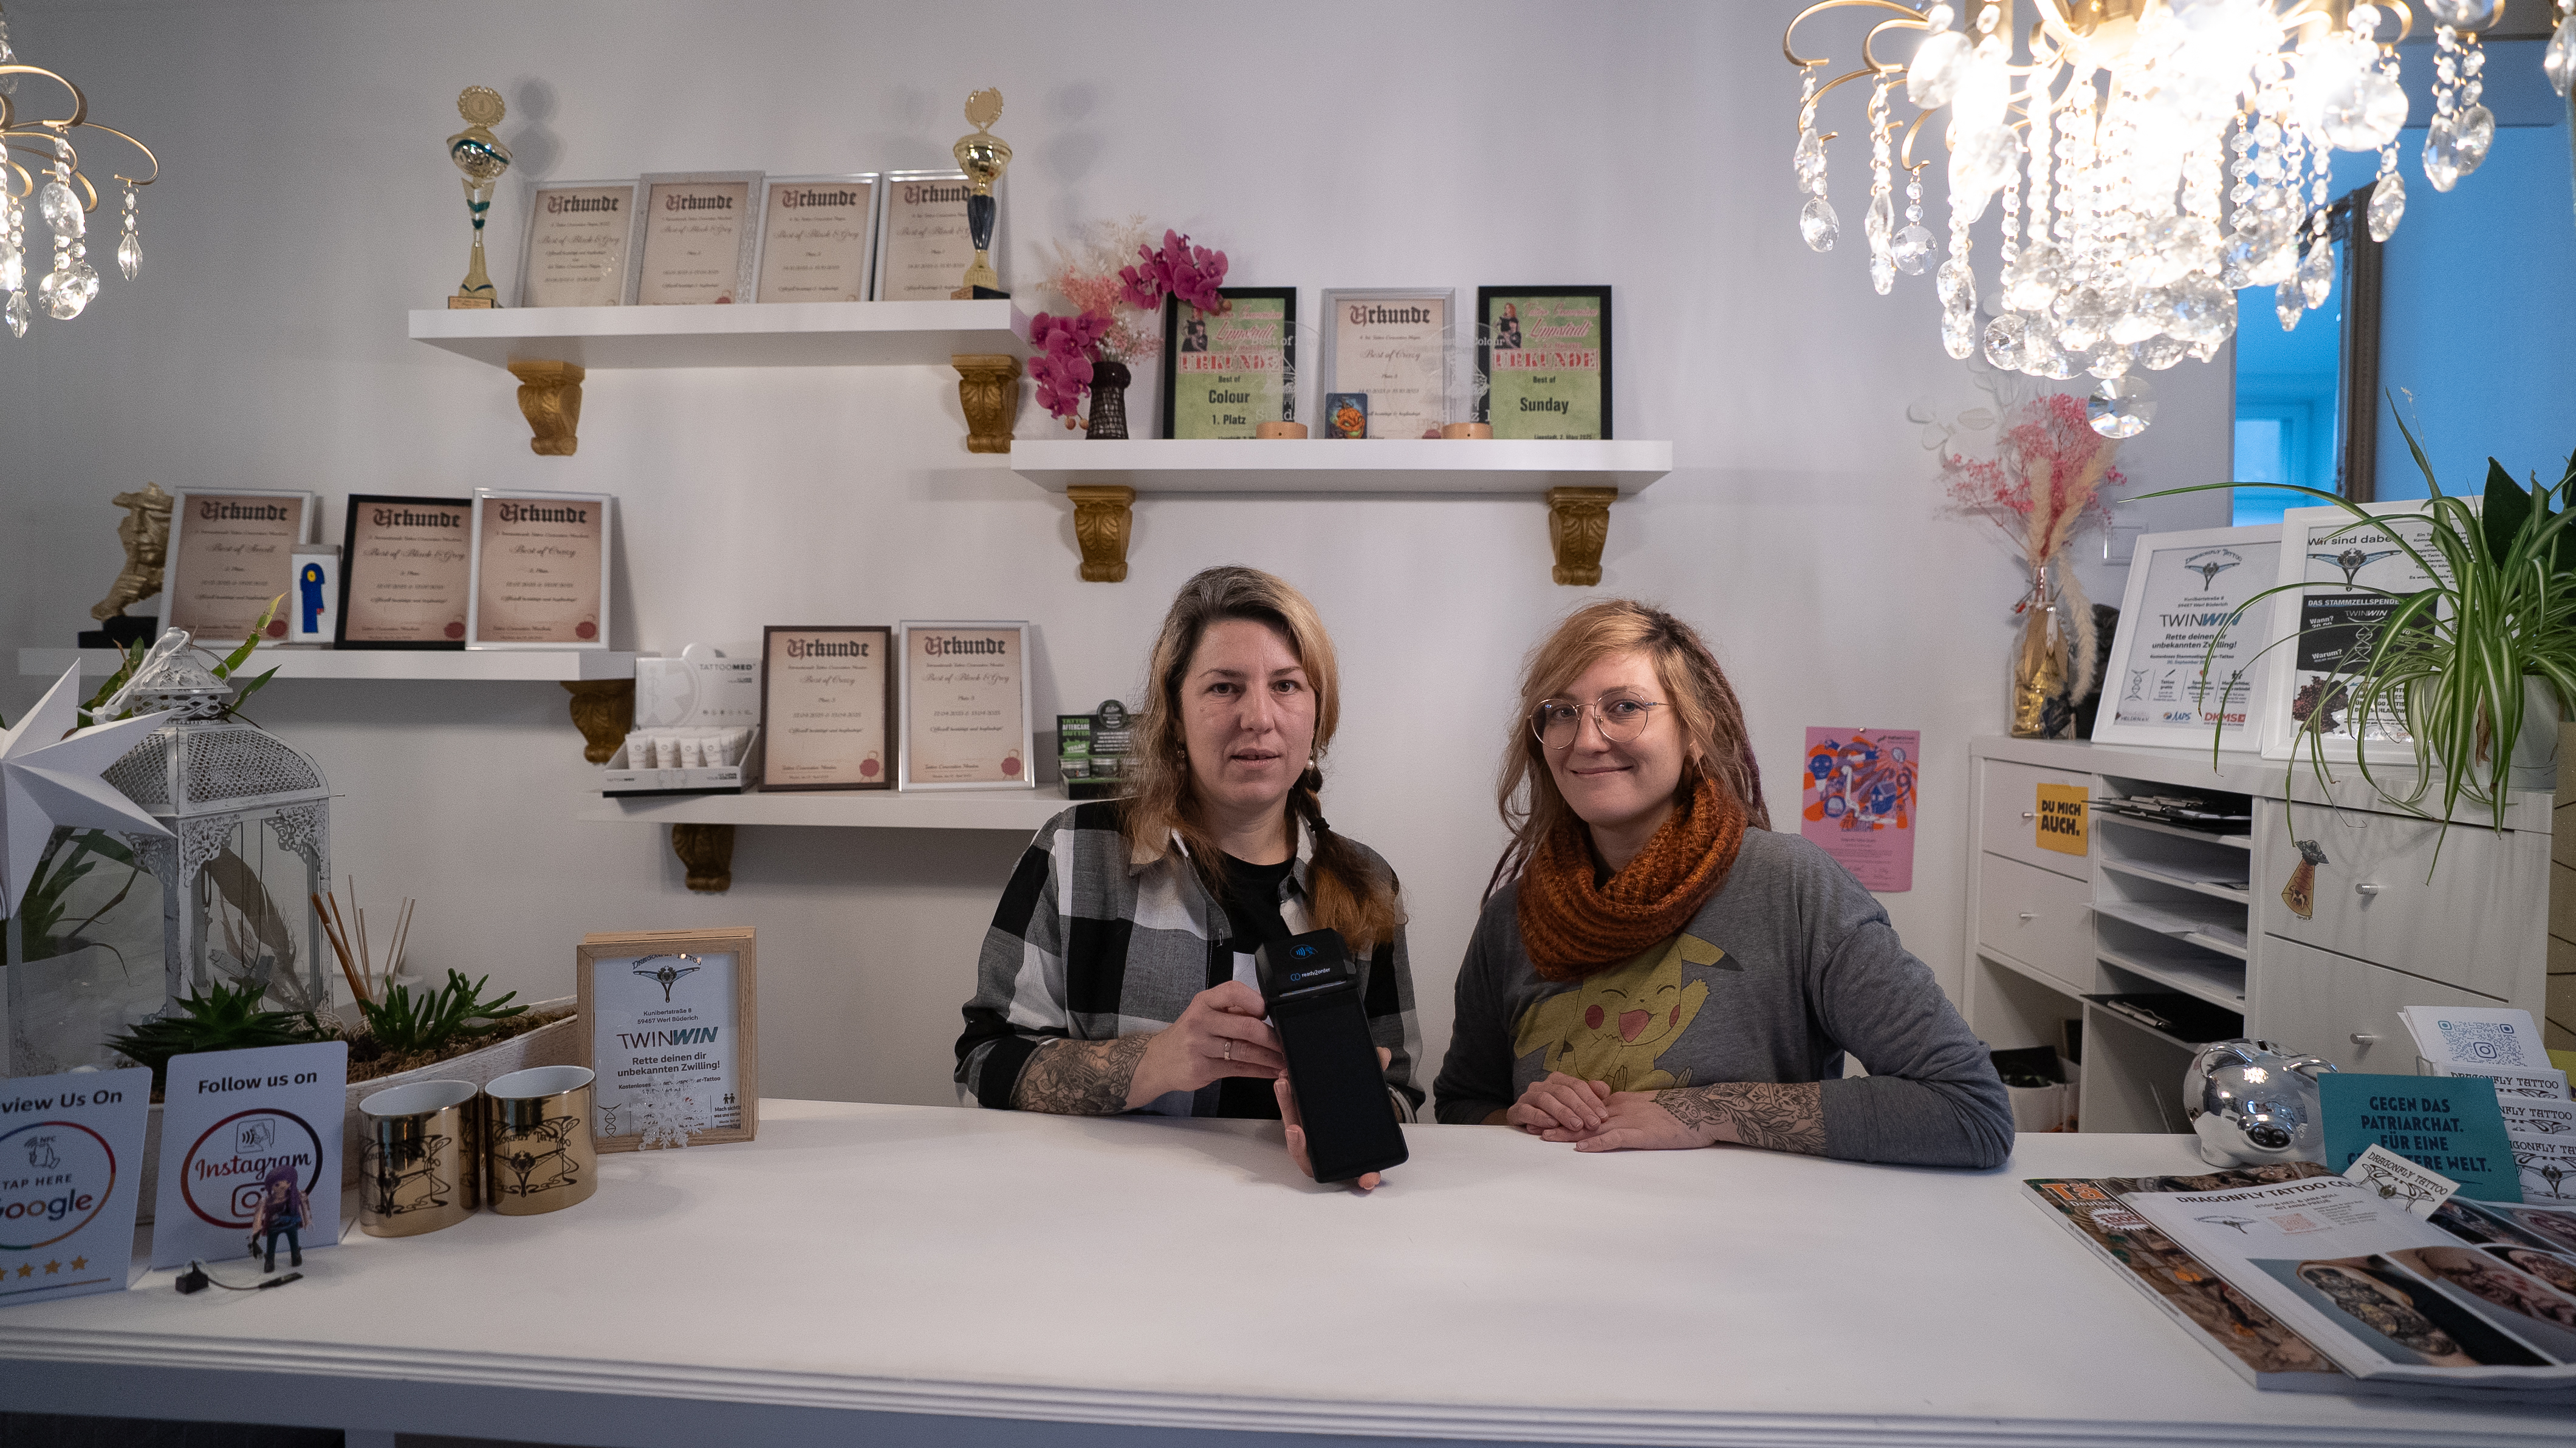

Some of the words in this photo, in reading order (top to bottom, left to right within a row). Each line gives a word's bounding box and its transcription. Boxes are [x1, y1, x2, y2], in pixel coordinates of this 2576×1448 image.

[547, 195, 618, 214] Urkunde
[666, 194, 733, 212] Urkunde
[782, 190, 857, 209] Urkunde
[905, 185, 977, 206] Urkund
[1349, 305, 1430, 327] Urkunde
[1527, 318, 1593, 341] Lippstadt
[1495, 352, 1595, 367] URKUNDE
[1208, 389, 1250, 404] Colour
[1520, 397, 1569, 415] Sunday
[1212, 415, 1220, 425] 1.
[1224, 414, 1246, 425] Platz
[200, 500, 287, 522] Urkunde
[373, 508, 461, 528] Urkunde
[499, 503, 587, 524] Urkunde
[2332, 535, 2357, 545] sind
[2360, 534, 2403, 544] dabe!
[2159, 612, 2243, 627] TWINWIN
[2309, 615, 2334, 624] Wann?
[787, 638, 869, 660] Urkunde
[924, 636, 1005, 657] Urkunde
[2312, 649, 2343, 660] Warum?
[2204, 712, 2238, 722] DKMS
[2041, 800, 2056, 813] DU
[2057, 802, 2081, 816] MICH
[2041, 815, 2080, 836] AUCH.
[1302, 968, 1331, 977] ready2order
[617, 1026, 718, 1049] TWINWIN
[617, 1065, 679, 1077] unbekannten
[681, 1060, 720, 1071] Zwilling!
[632, 1057, 658, 1065] Rette
[660, 1054, 692, 1063] deinen
[199, 1076, 261, 1094] Follow
[267, 1074, 288, 1087] us
[294, 1072, 317, 1084] on
[2516, 1077, 2558, 1089] TATTOO
[60, 1093, 86, 1108] Us
[93, 1090, 122, 1105] On
[2369, 1096, 2417, 1112] GEGEN
[2422, 1098, 2450, 1113] DAS
[2529, 1108, 2572, 1121] TATTOO
[2361, 1115, 2464, 1133] PATRIARCHAT.
[2380, 1131, 2410, 1150] FÜR
[2414, 1136, 2449, 1151] EINE
[195, 1153, 312, 1181] Instagram
[2368, 1152, 2415, 1178] DRAGONFLY
[2414, 1175, 2448, 1195] TATTOO
[2446, 1156, 2492, 1173] WELT.
[2, 1179, 29, 1190] TAP
[36, 1174, 72, 1187] HERE
[2176, 1192, 2267, 1203] DRAGONFLY
[2266, 1183, 2326, 1197] TATTOO
[0, 1189, 92, 1221] oogle
